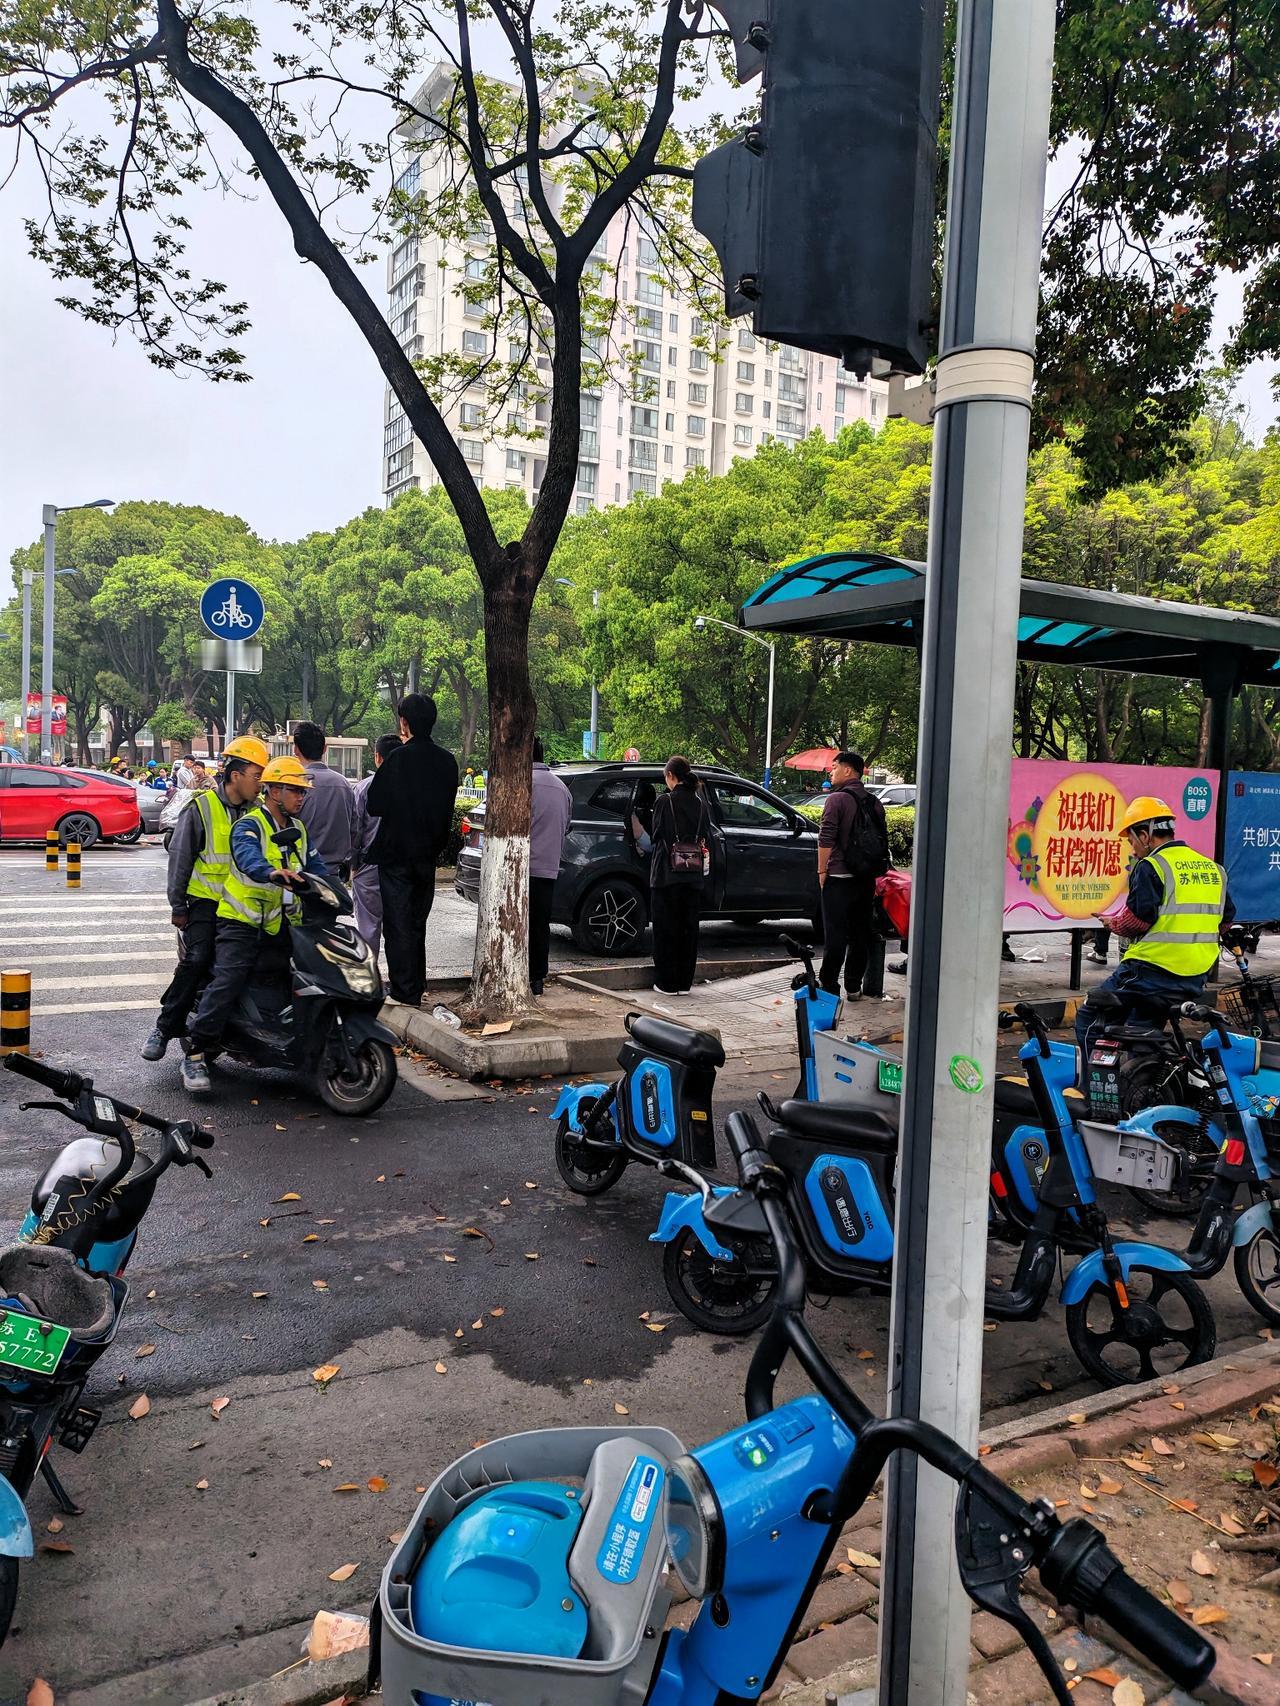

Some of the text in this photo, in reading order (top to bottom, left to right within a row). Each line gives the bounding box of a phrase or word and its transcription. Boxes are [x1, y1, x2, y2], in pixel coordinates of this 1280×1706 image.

[1187, 786, 1208, 796] BOSS
[1057, 790, 1115, 832] 祝我们
[1187, 798, 1207, 812] 直聘
[1243, 827, 1280, 847] 共创文
[1046, 836, 1121, 878] 得偿所愿
[1179, 872, 1220, 885] 苏州恒基
[24, 1328, 40, 1343] E
[603, 1523, 626, 1572] 请在小程序
